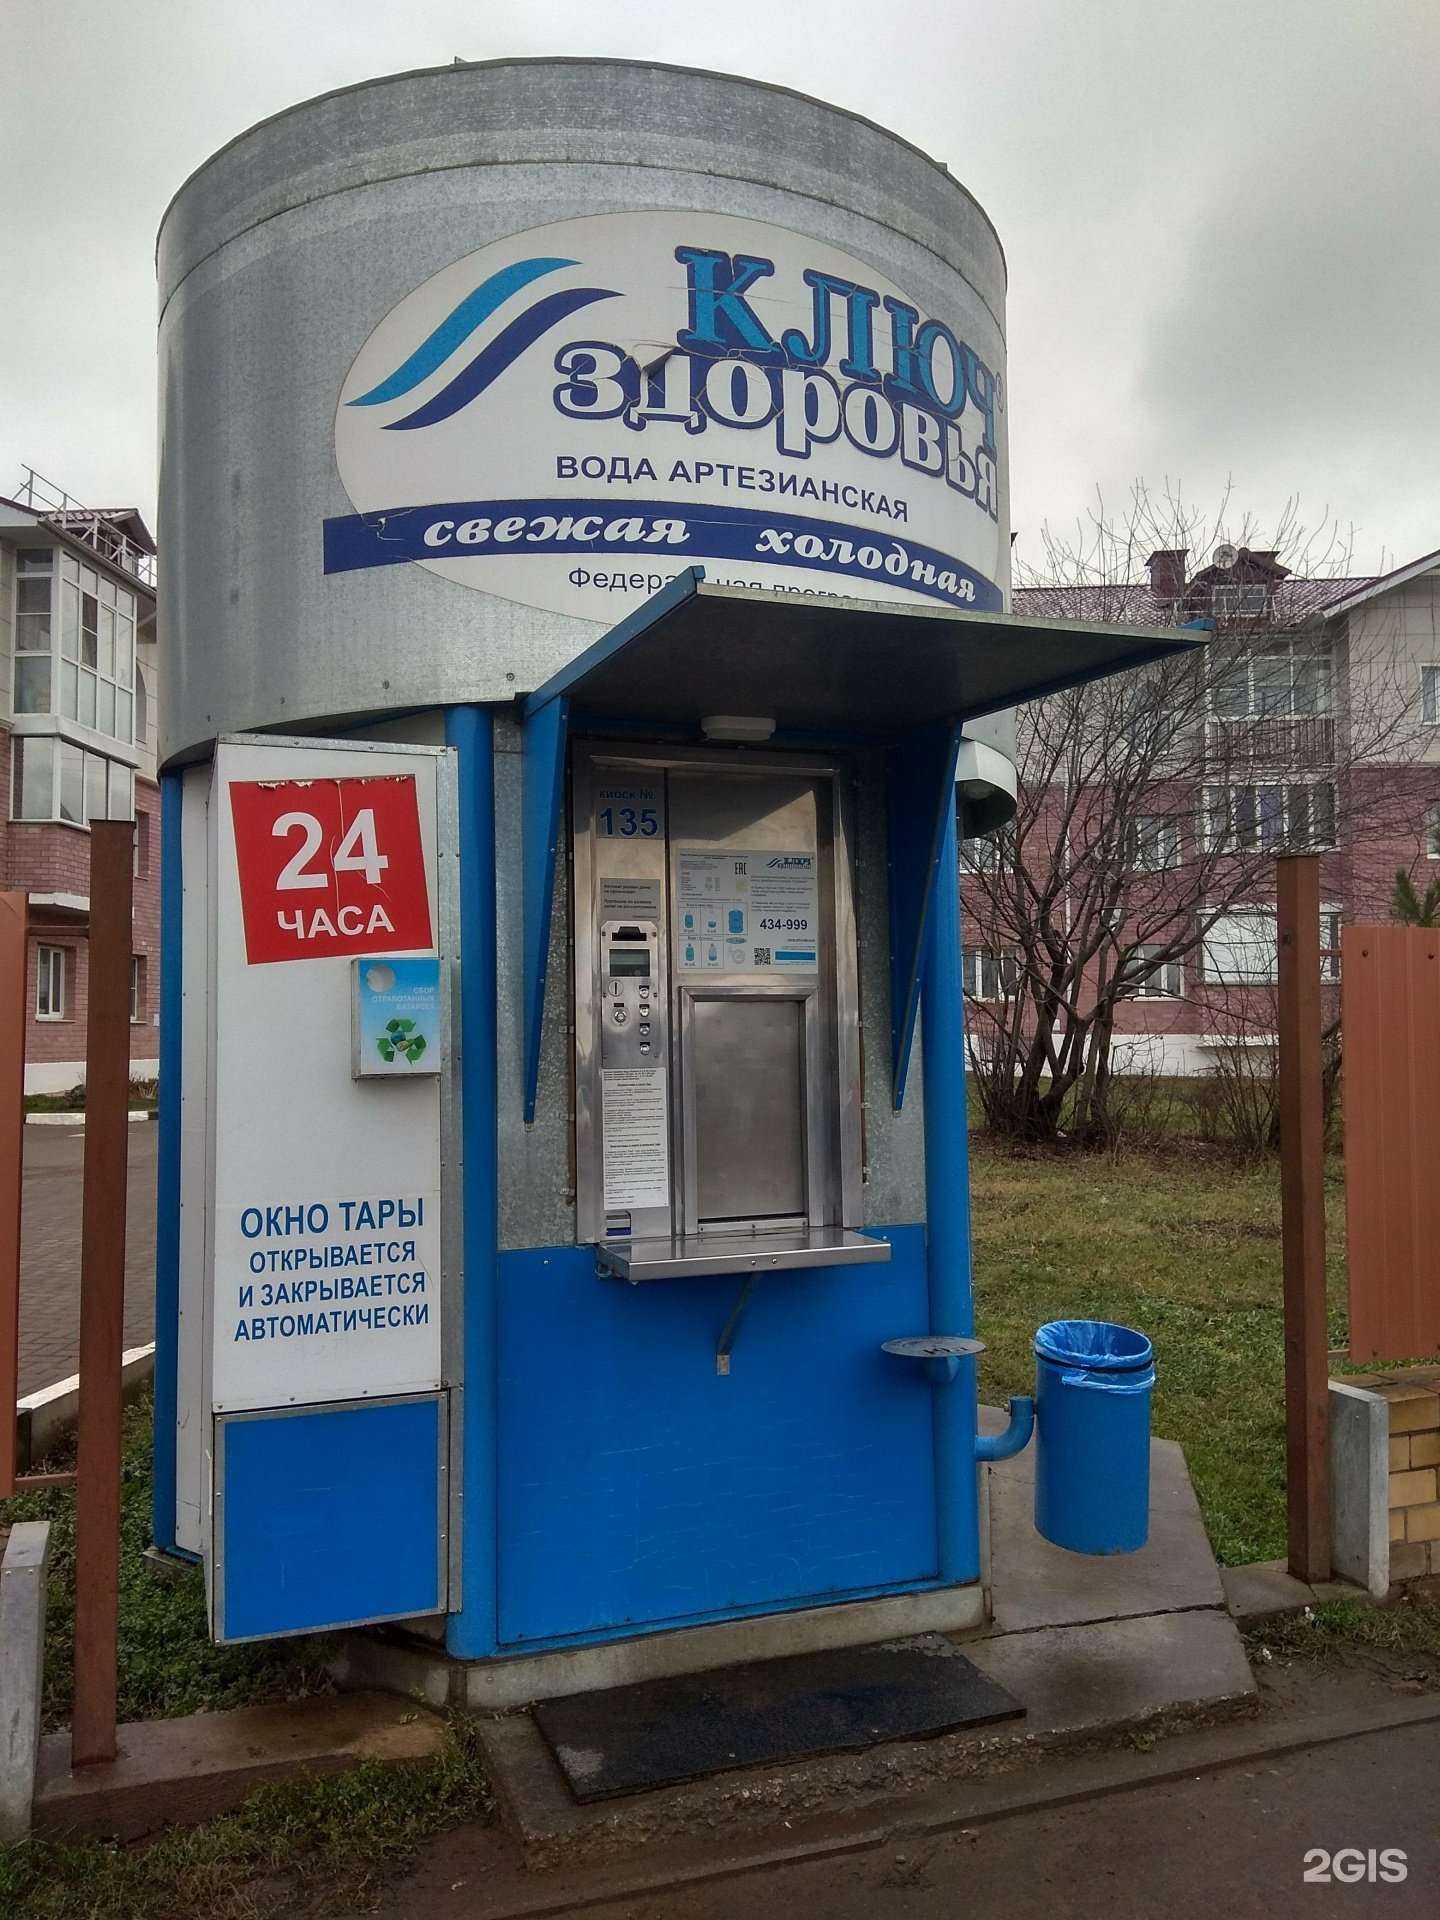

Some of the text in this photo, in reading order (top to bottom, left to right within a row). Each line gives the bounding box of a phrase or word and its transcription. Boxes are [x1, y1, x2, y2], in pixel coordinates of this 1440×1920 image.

[674, 246, 998, 456] КЛЮЧ
[556, 456, 909, 523] ВОДА АРТЕЗИАНСКАЯ
[423, 513, 976, 602] свежая холодная
[600, 807, 658, 836] 135
[271, 808, 389, 891] 24
[277, 904, 396, 940] ЧАСА
[759, 918, 808, 931] 434-999
[240, 1197, 424, 1238] ОКНО ТАРЫ
[249, 1240, 416, 1274] ОТКРЫВАЕТСЯ
[239, 1271, 425, 1308] И ЗАКРЫВАЕТСЯ
[233, 1303, 430, 1342] АВТОМАТИЧЕСКИ
